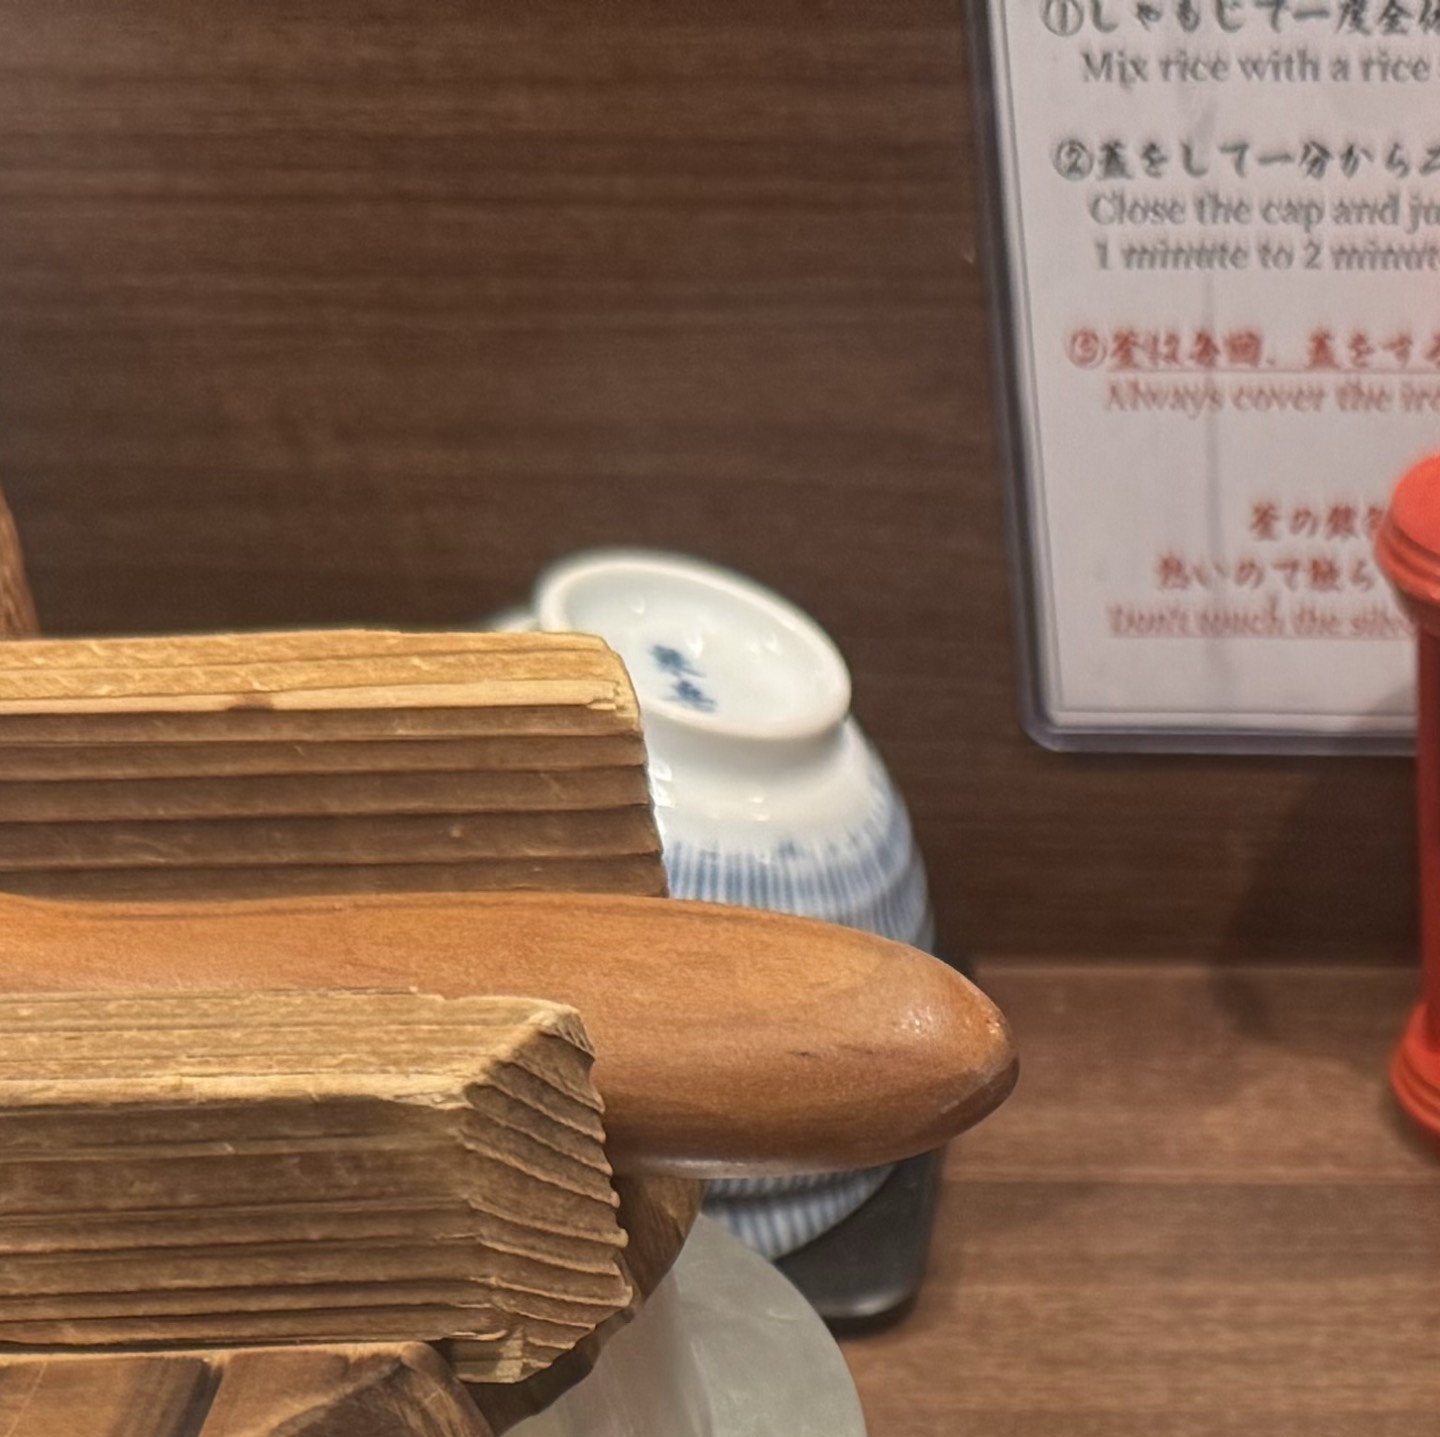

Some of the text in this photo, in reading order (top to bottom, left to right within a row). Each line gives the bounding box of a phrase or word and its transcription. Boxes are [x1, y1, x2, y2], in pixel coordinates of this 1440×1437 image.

[1081, 51, 1149, 90] Mix
[1159, 50, 1229, 82] rice
[1238, 50, 1321, 82] with
[1331, 57, 1350, 82] a
[1360, 50, 1430, 82] rice
[1089, 194, 1186, 226] Close
[1195, 190, 1252, 225] the
[1261, 203, 1325, 234] cap
[1333, 194, 1401, 226] and
[1096, 241, 1110, 269] 1
[1122, 241, 1250, 270] minute
[1261, 245, 1294, 270] to
[1304, 242, 1324, 270] 2
[1106, 381, 1222, 419] Always
[1233, 386, 1326, 412] cover
[1336, 382, 1389, 413] the
[1292, 605, 1342, 636] the
